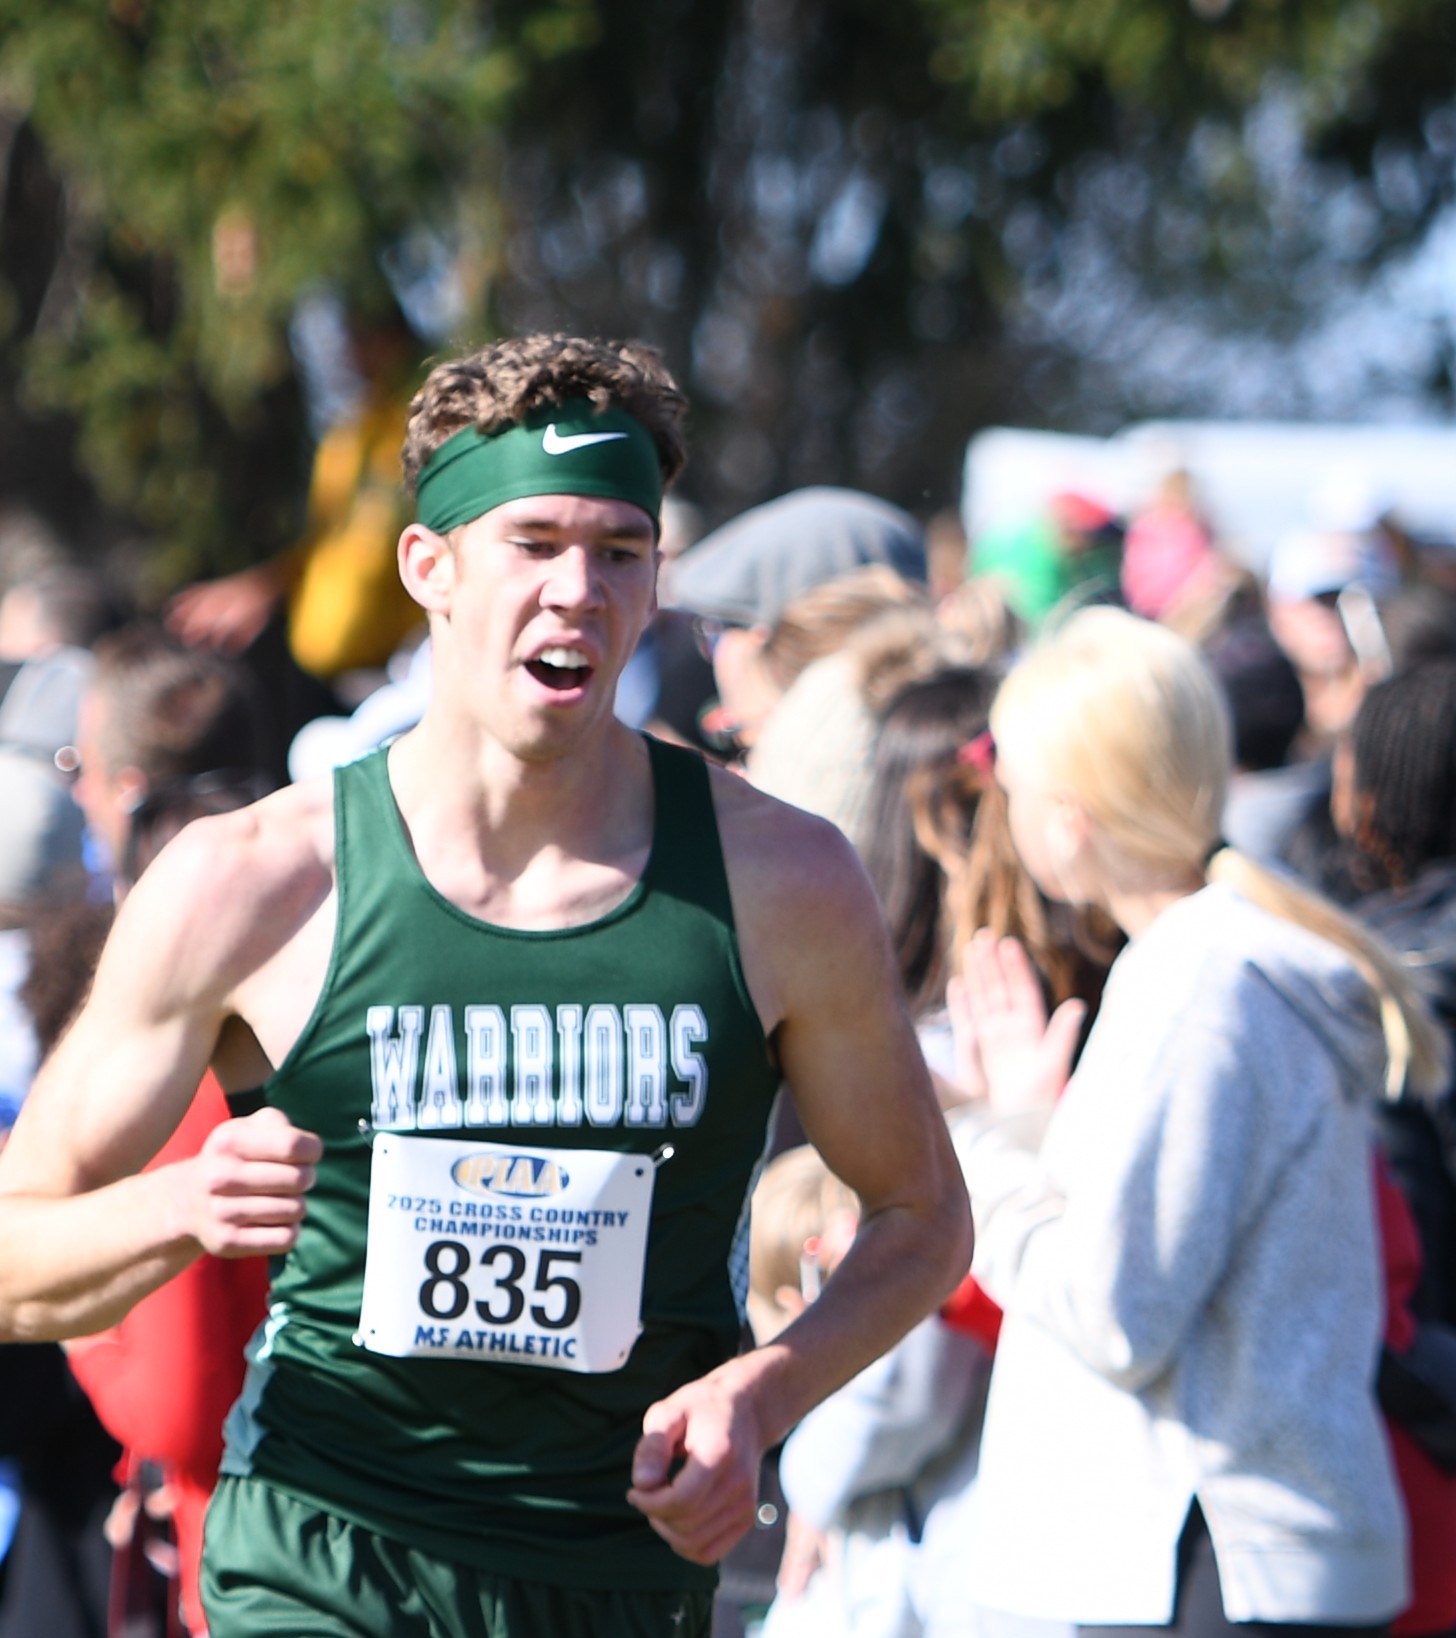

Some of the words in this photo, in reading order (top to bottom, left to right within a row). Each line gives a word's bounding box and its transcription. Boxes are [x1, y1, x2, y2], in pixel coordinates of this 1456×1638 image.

[366, 1003, 709, 1130] WARRIORS
[465, 1155, 564, 1196] PIAA
[387, 1194, 442, 1214] 2025
[449, 1201, 522, 1221] CROSS
[530, 1207, 630, 1228] COUNTRY
[414, 1216, 599, 1246] CHAMPIONSHIPS
[418, 1240, 583, 1330] 835
[455, 1329, 577, 1359] ATHLETIC
